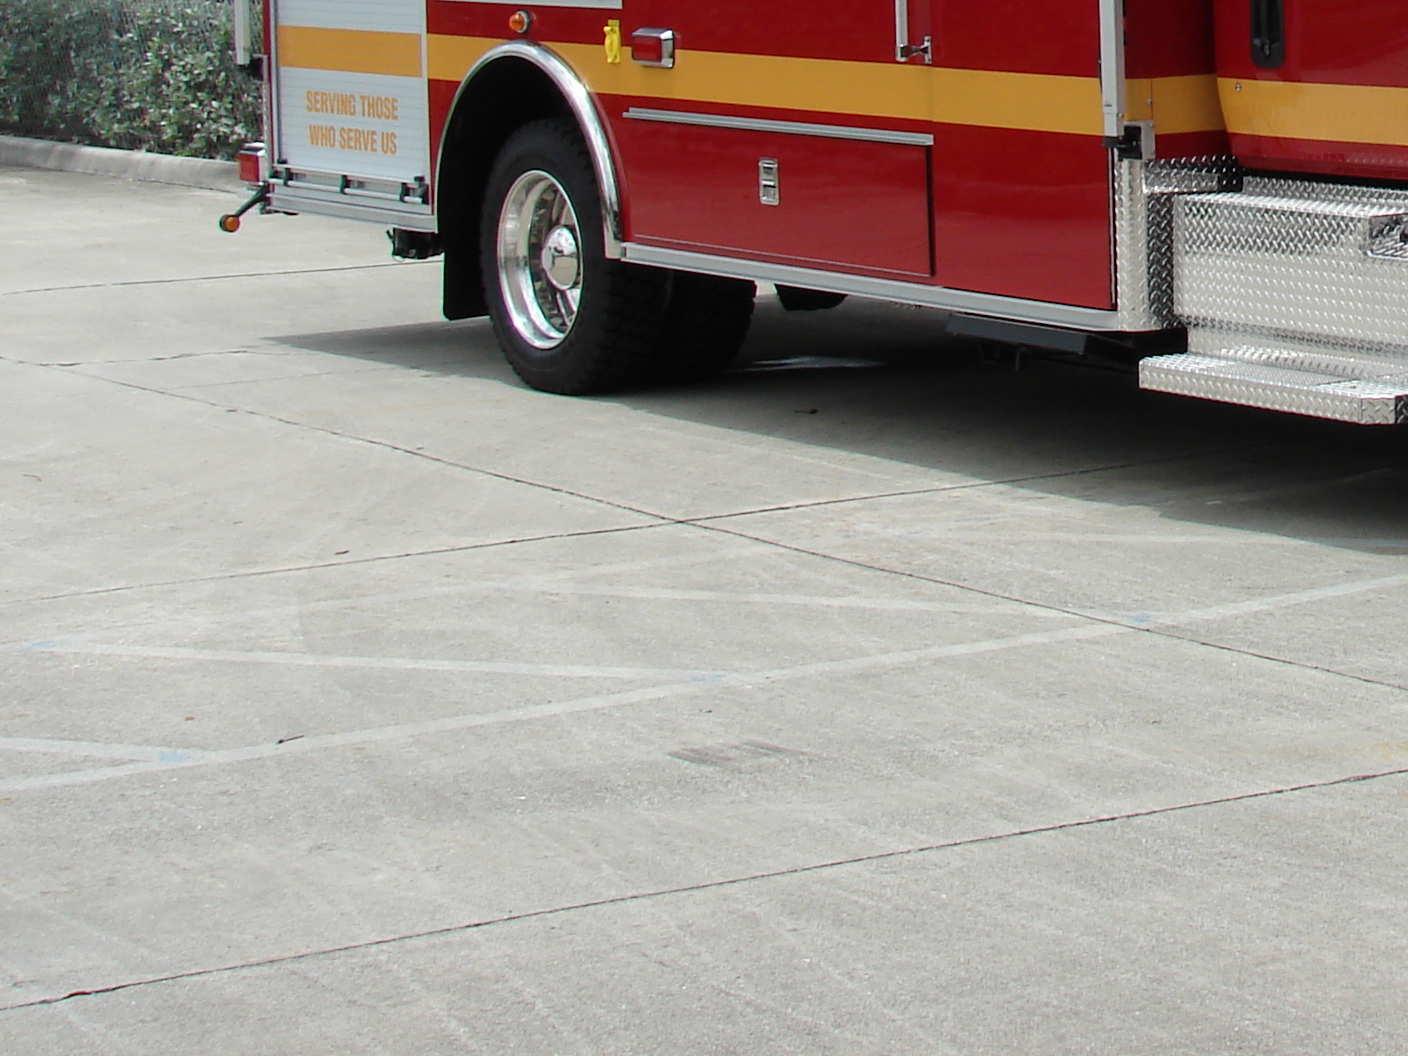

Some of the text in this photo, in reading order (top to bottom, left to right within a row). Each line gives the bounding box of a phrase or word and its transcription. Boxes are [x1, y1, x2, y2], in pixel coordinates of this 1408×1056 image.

[306, 90, 399, 120] SERVING THOSE
[309, 124, 397, 154] WHO SERVE US
